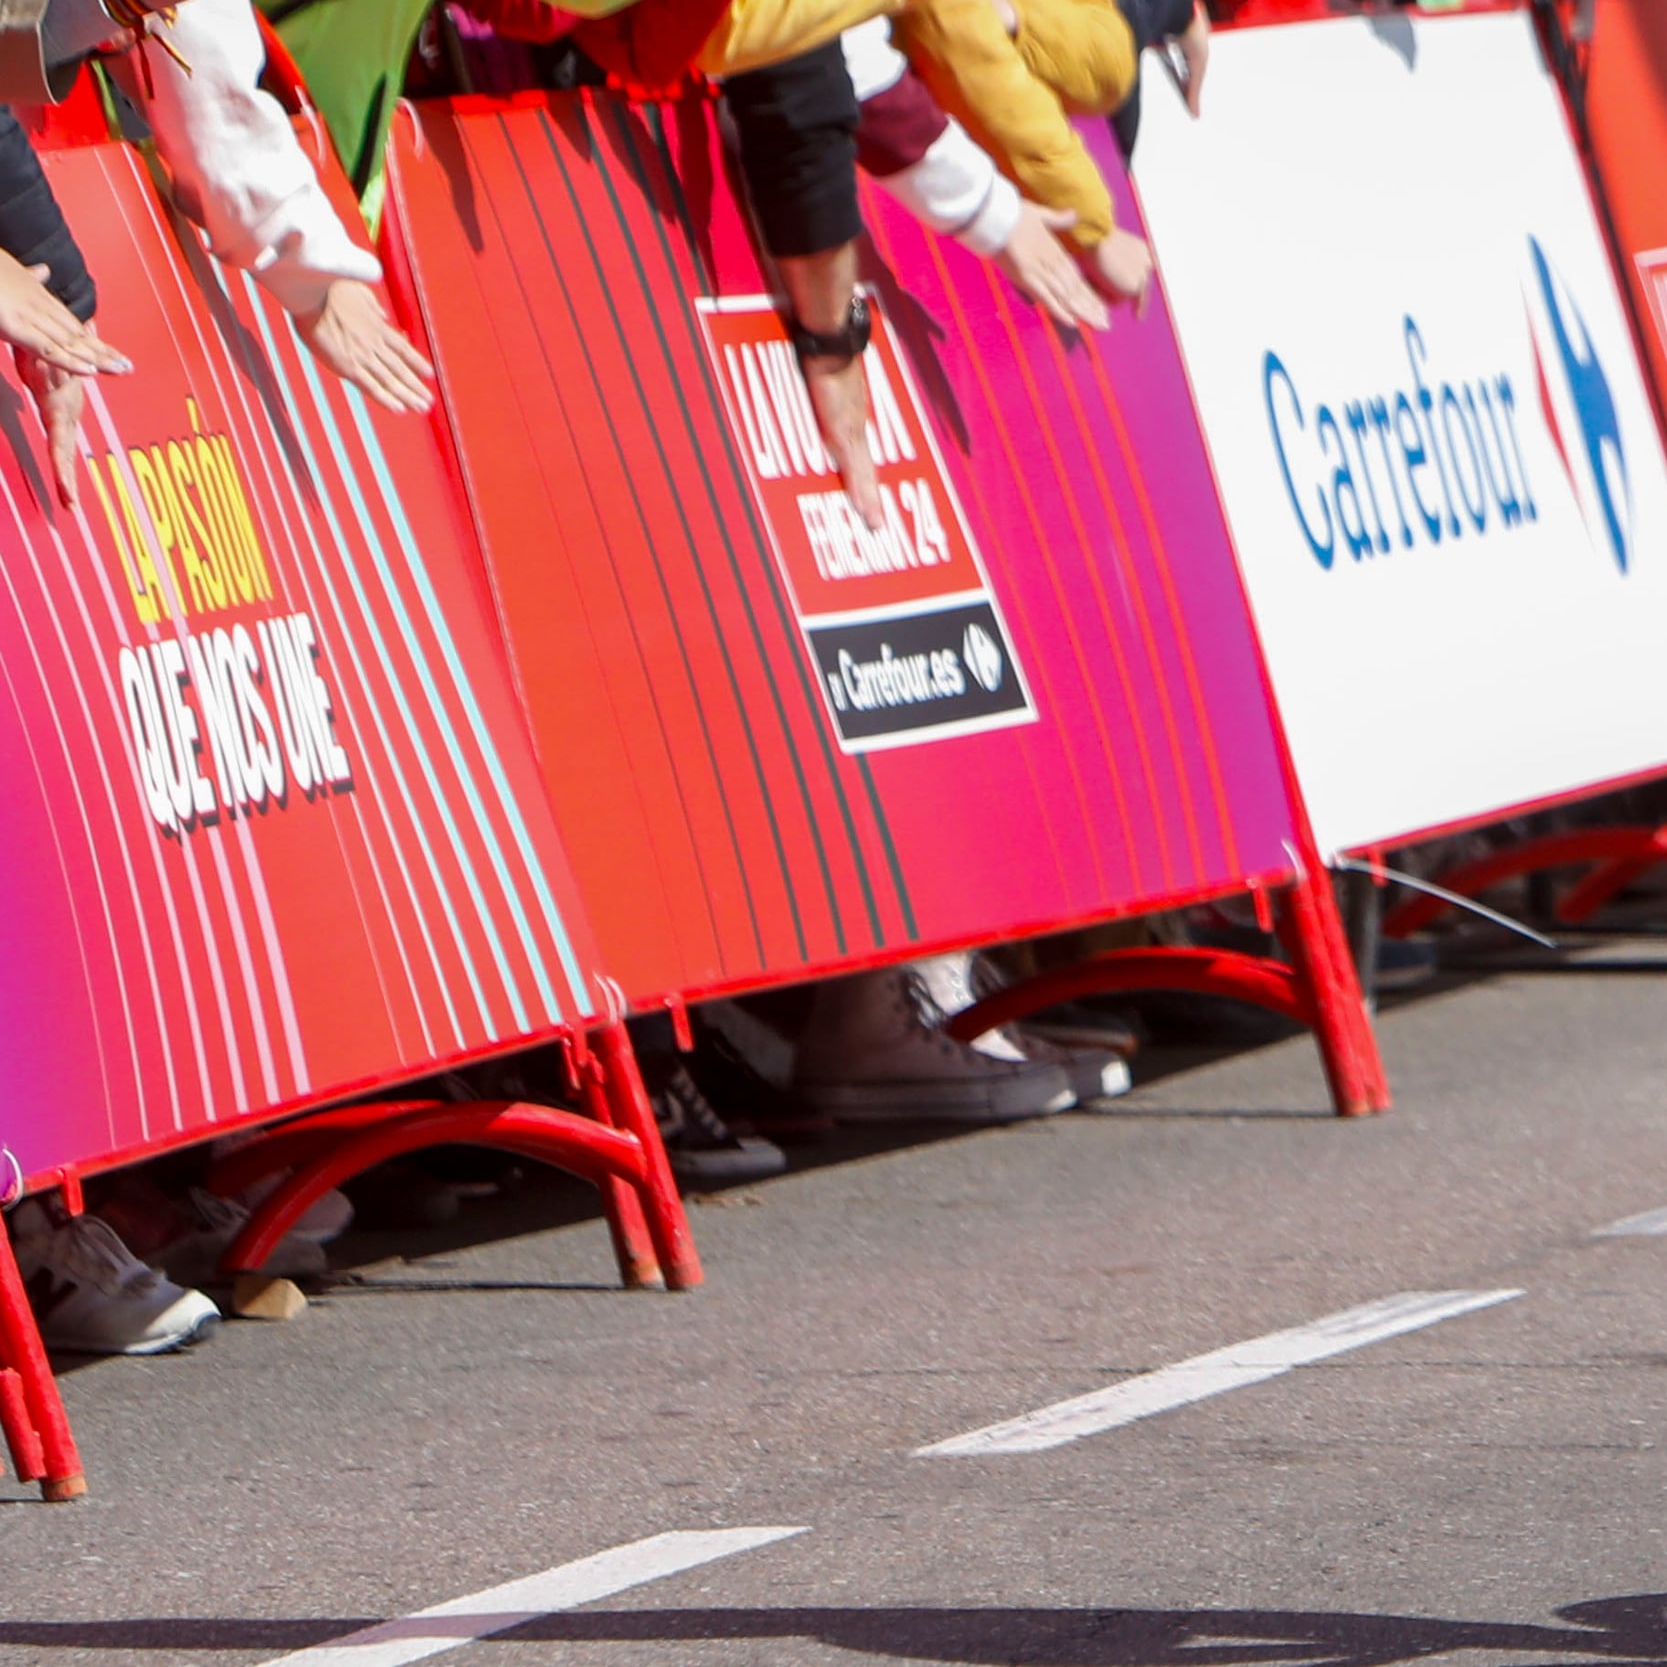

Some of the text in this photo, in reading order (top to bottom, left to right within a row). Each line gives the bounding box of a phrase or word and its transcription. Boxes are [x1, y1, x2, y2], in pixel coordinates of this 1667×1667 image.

[88, 395, 274, 624] LA PASIÓN
[1262, 313, 1538, 572] Carrefour
[118, 611, 354, 837] QUE NOS UNE
[837, 642, 966, 712] Carrefour.es
